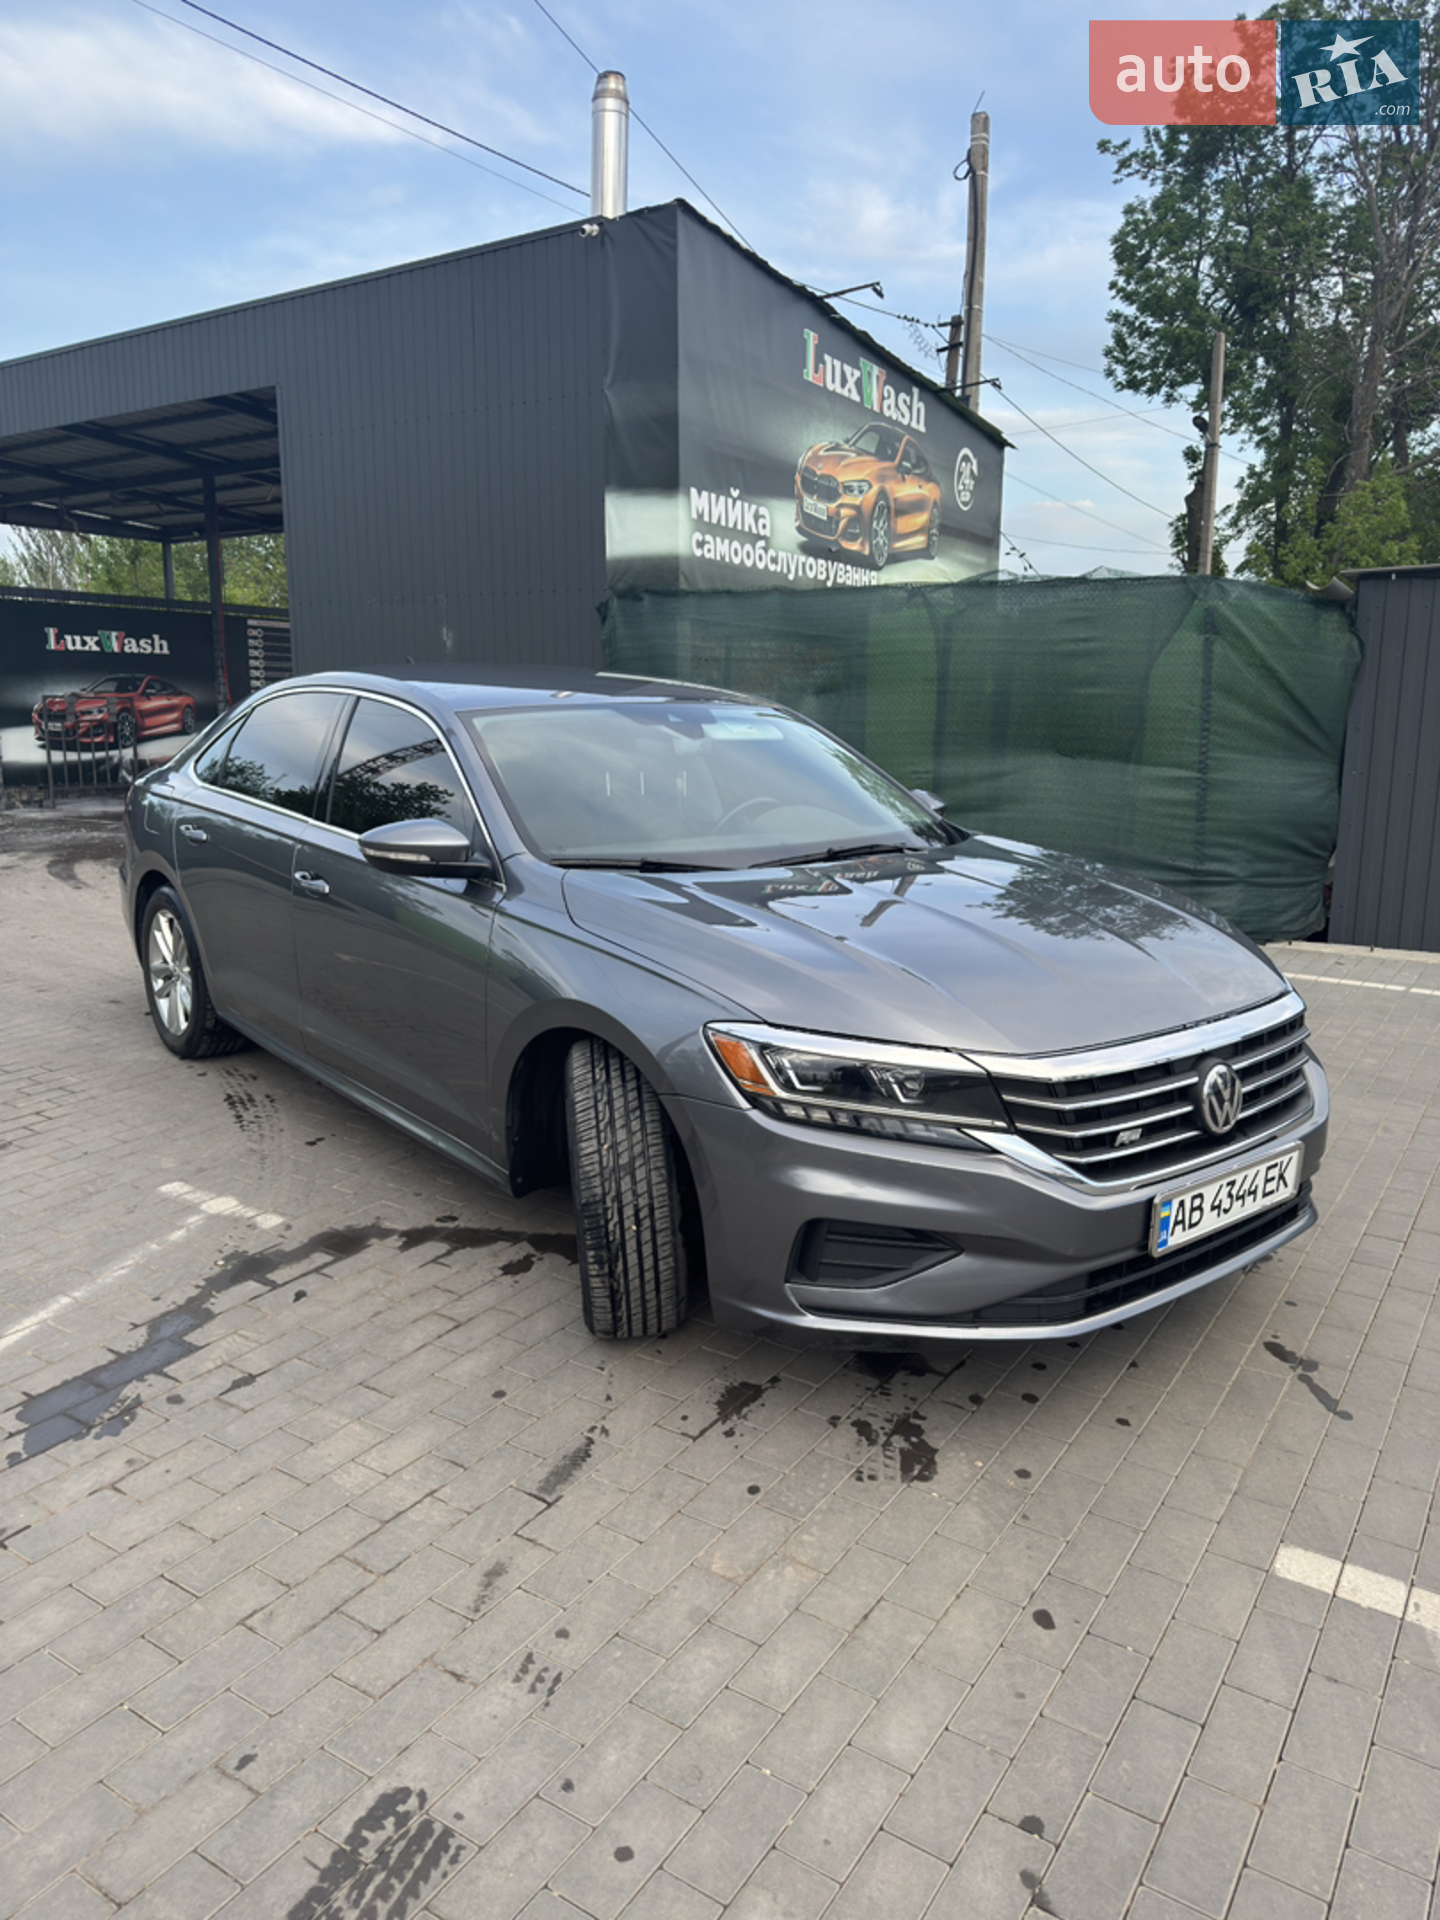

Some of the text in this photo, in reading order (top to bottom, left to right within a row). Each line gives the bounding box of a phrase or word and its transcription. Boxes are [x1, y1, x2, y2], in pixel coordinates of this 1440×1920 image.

[1170, 1156, 1293, 1236] AB 4344 EK
